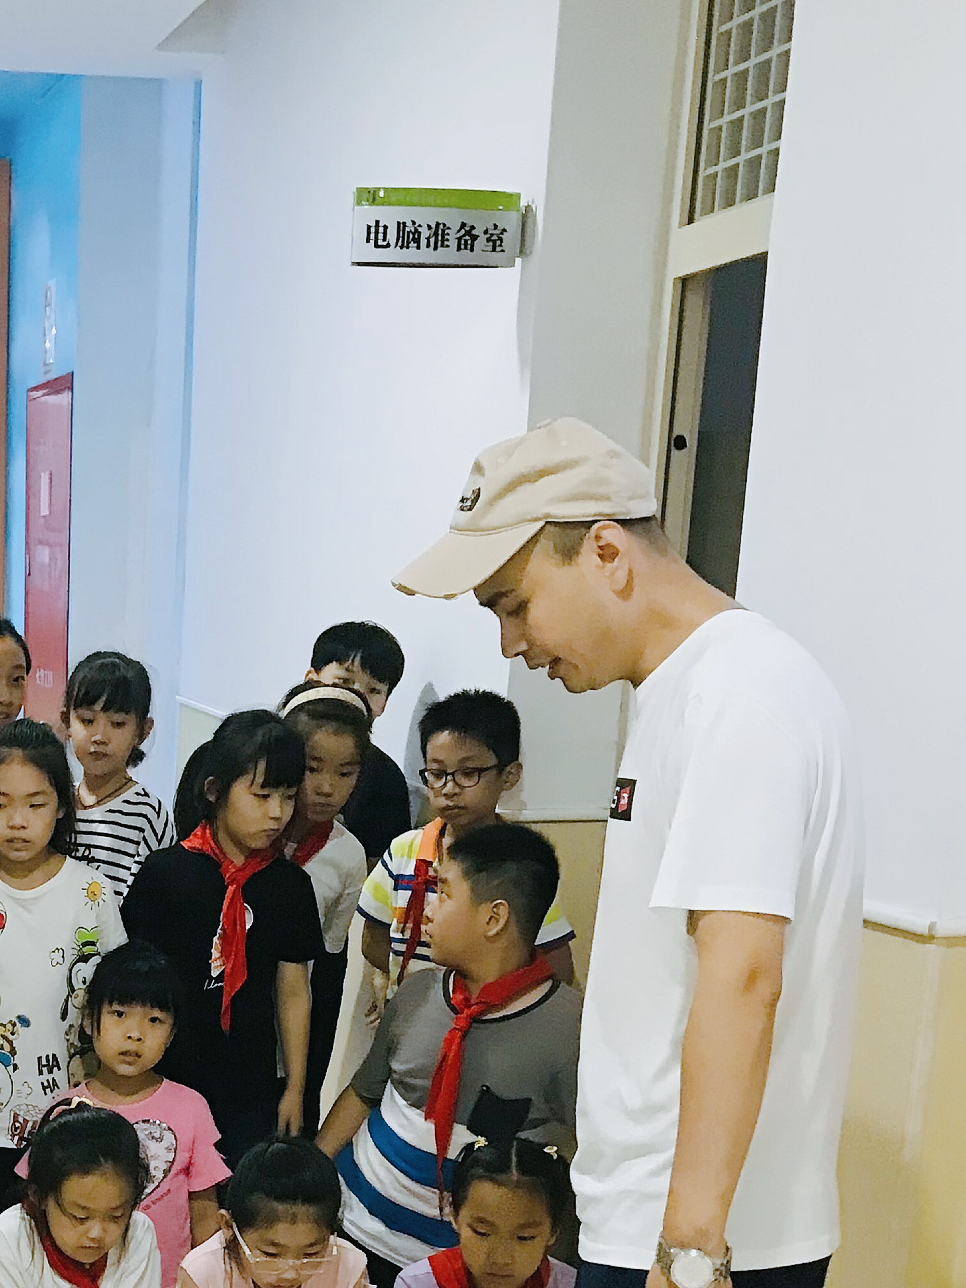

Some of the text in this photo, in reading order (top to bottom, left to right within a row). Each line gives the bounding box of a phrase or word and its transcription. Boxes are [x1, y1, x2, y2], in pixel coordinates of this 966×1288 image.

[365, 219, 509, 253] 电脑准备室
[36, 1053, 62, 1076] HA
[40, 1077, 61, 1096] HA
